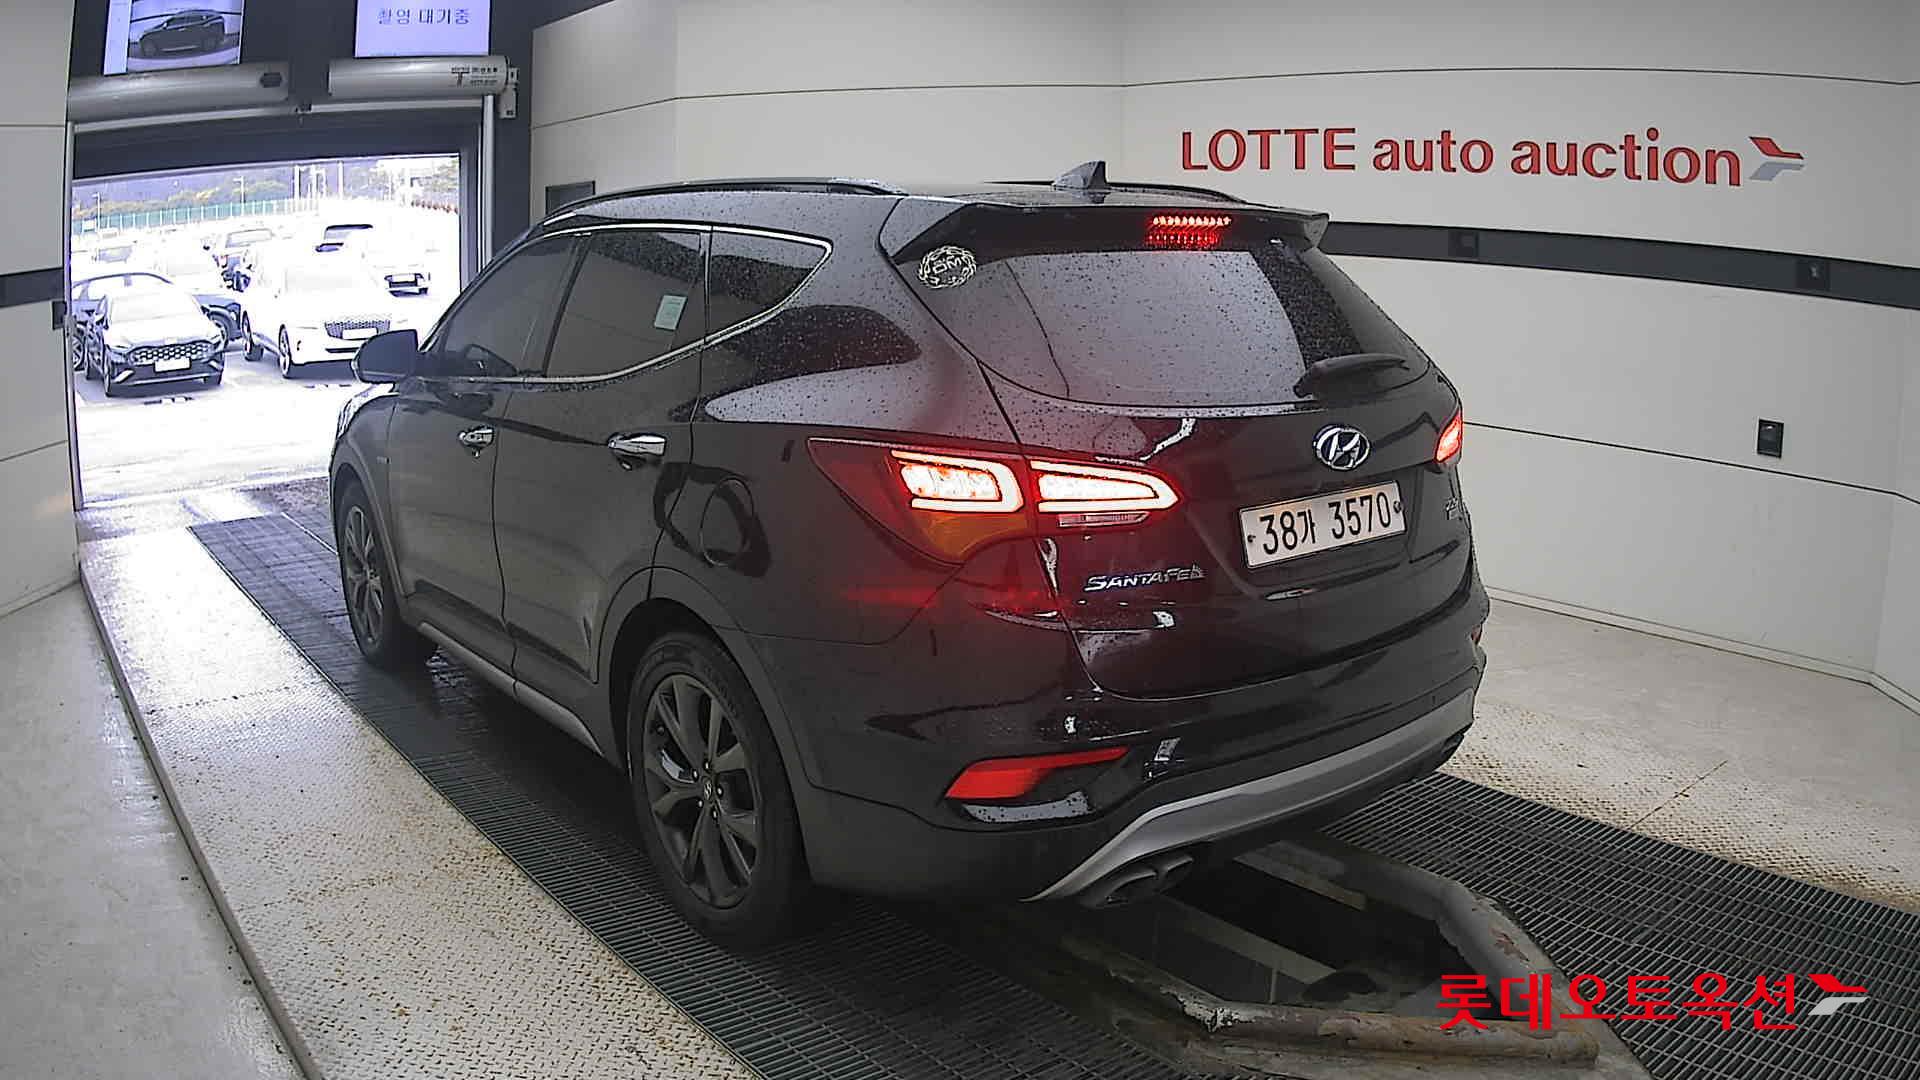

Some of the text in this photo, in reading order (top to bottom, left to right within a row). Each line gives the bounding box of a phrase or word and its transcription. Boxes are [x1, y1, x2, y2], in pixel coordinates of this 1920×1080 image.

[418, 8, 470, 25] 대기중
[1181, 127, 1742, 187] LOTTE auto auction
[1259, 508, 1316, 556] 38가
[1328, 491, 1391, 540] 3570
